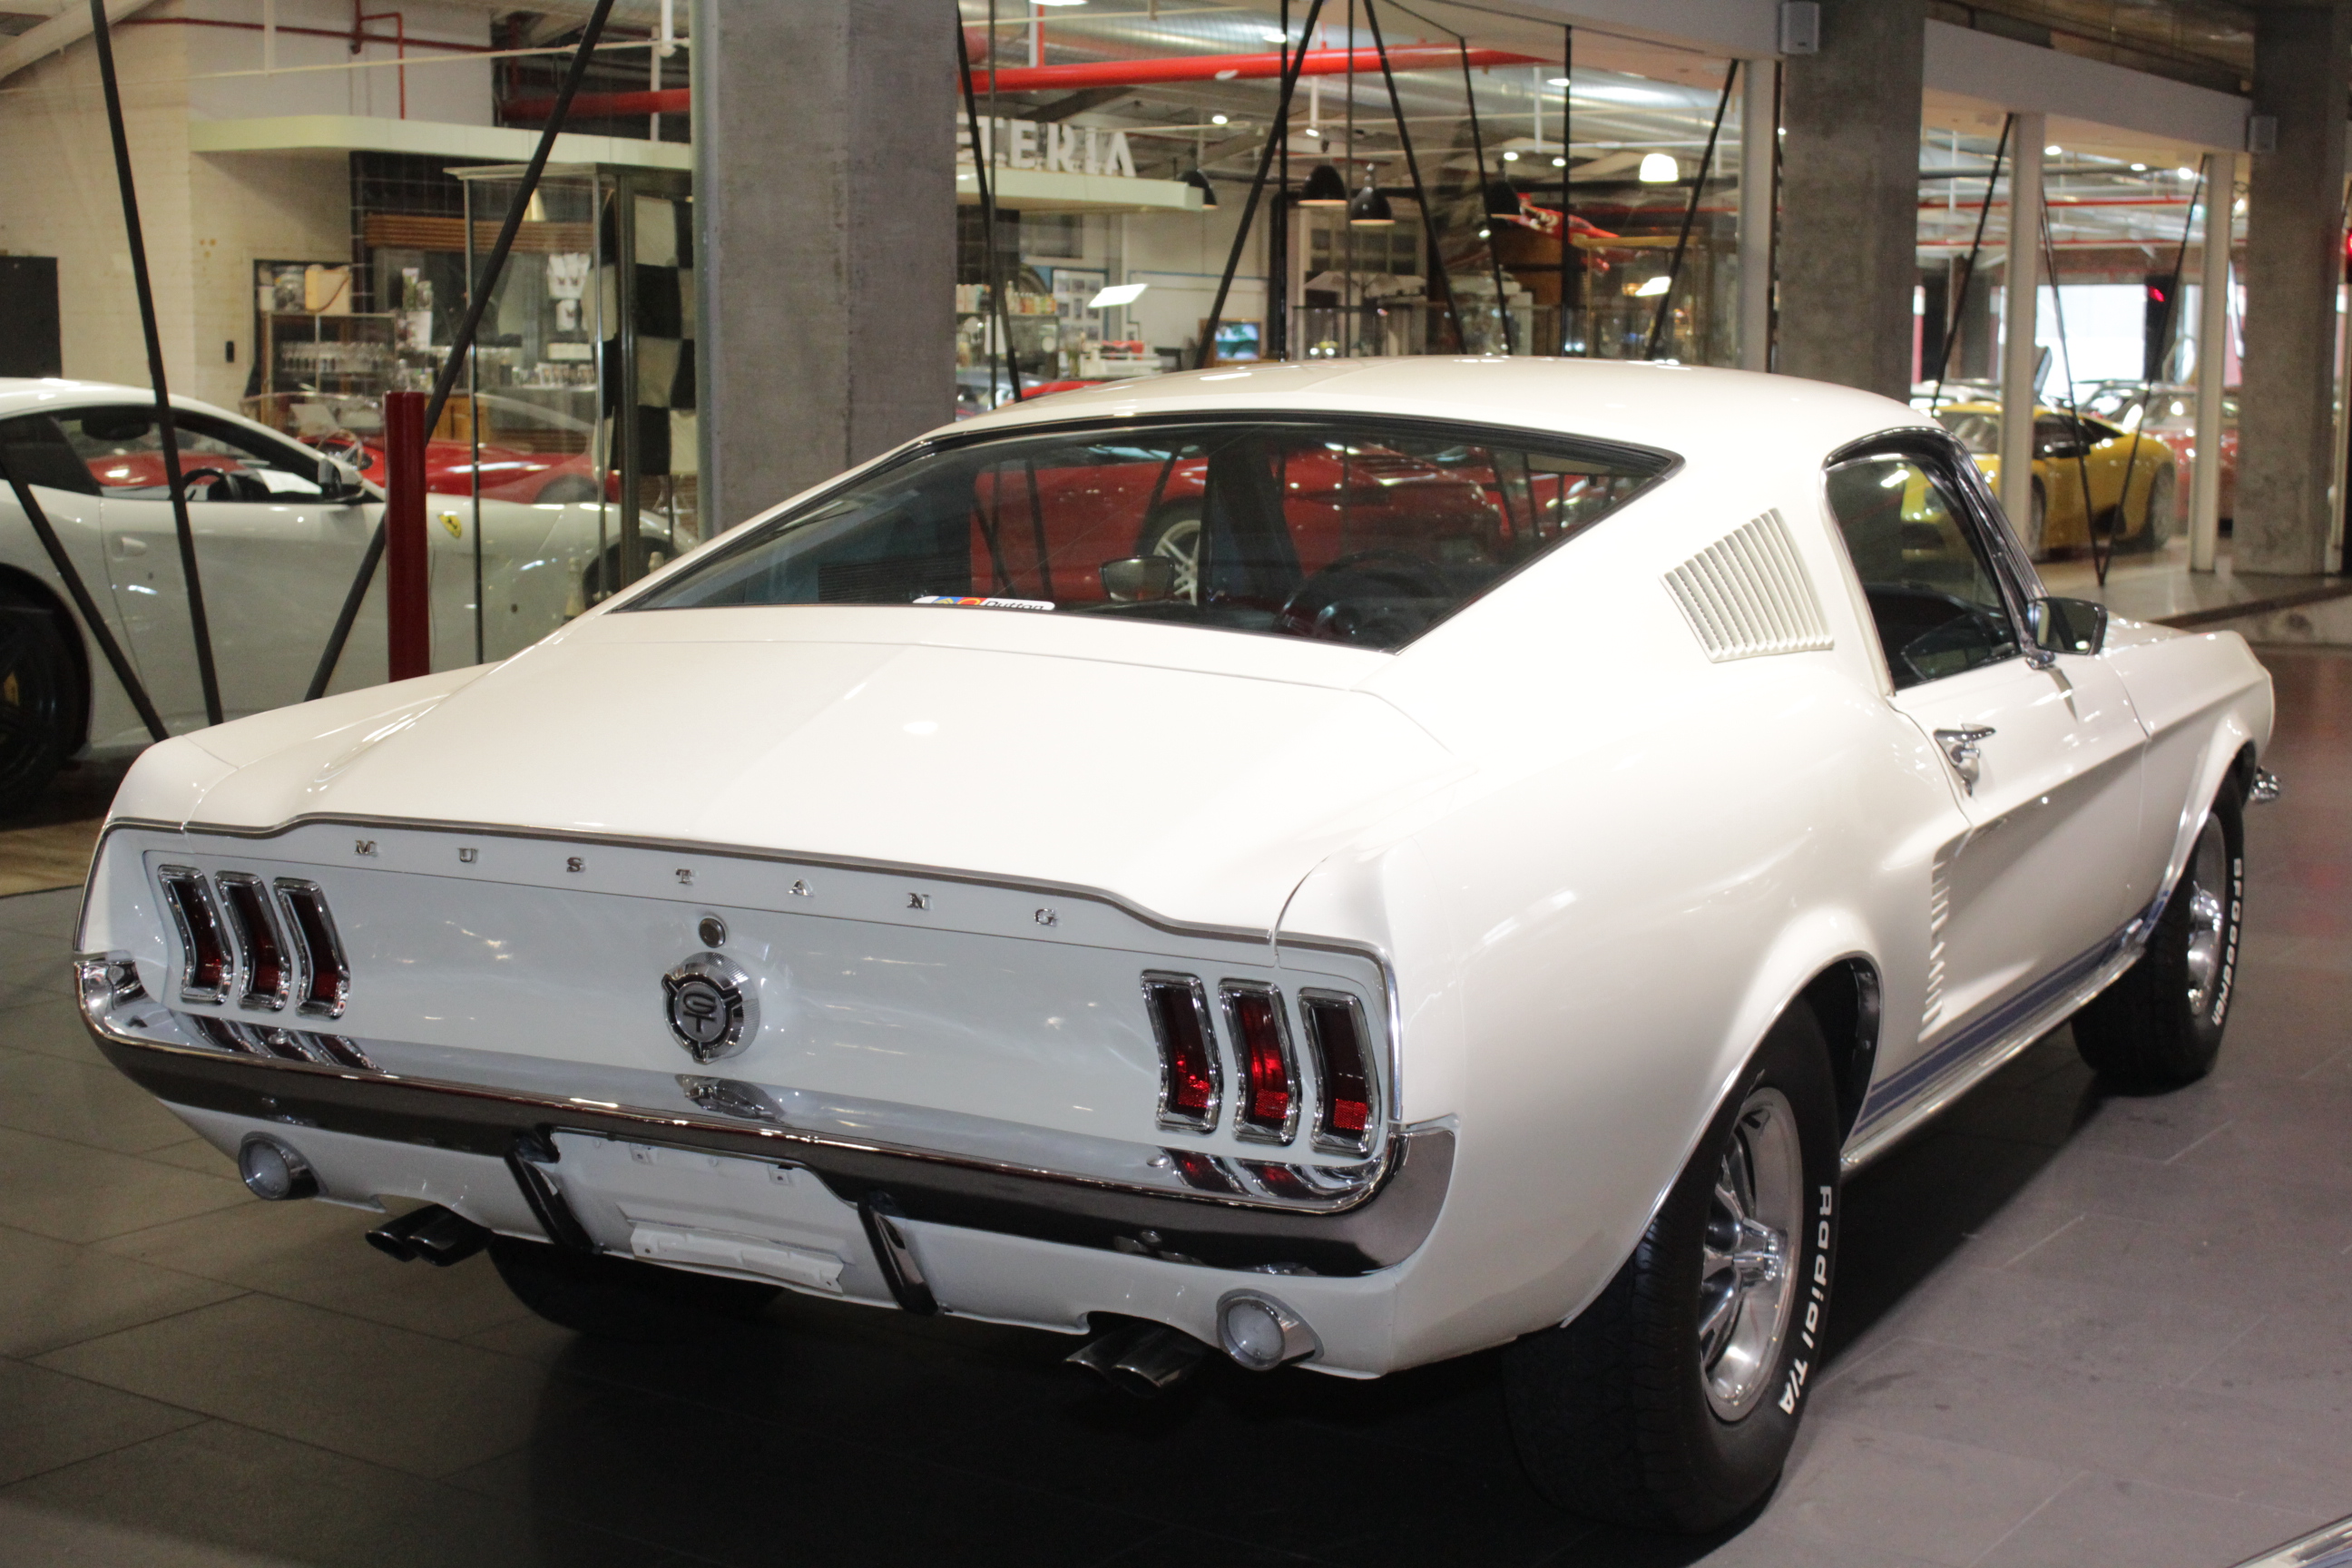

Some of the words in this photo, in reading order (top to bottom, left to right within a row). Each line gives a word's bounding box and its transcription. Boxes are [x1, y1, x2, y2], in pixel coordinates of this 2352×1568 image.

[355, 839, 1060, 926] MUSTANG
[683, 992, 717, 1033] GT
[1801, 1185, 1832, 1349] Radial
[1778, 1358, 1808, 1415] T/A
